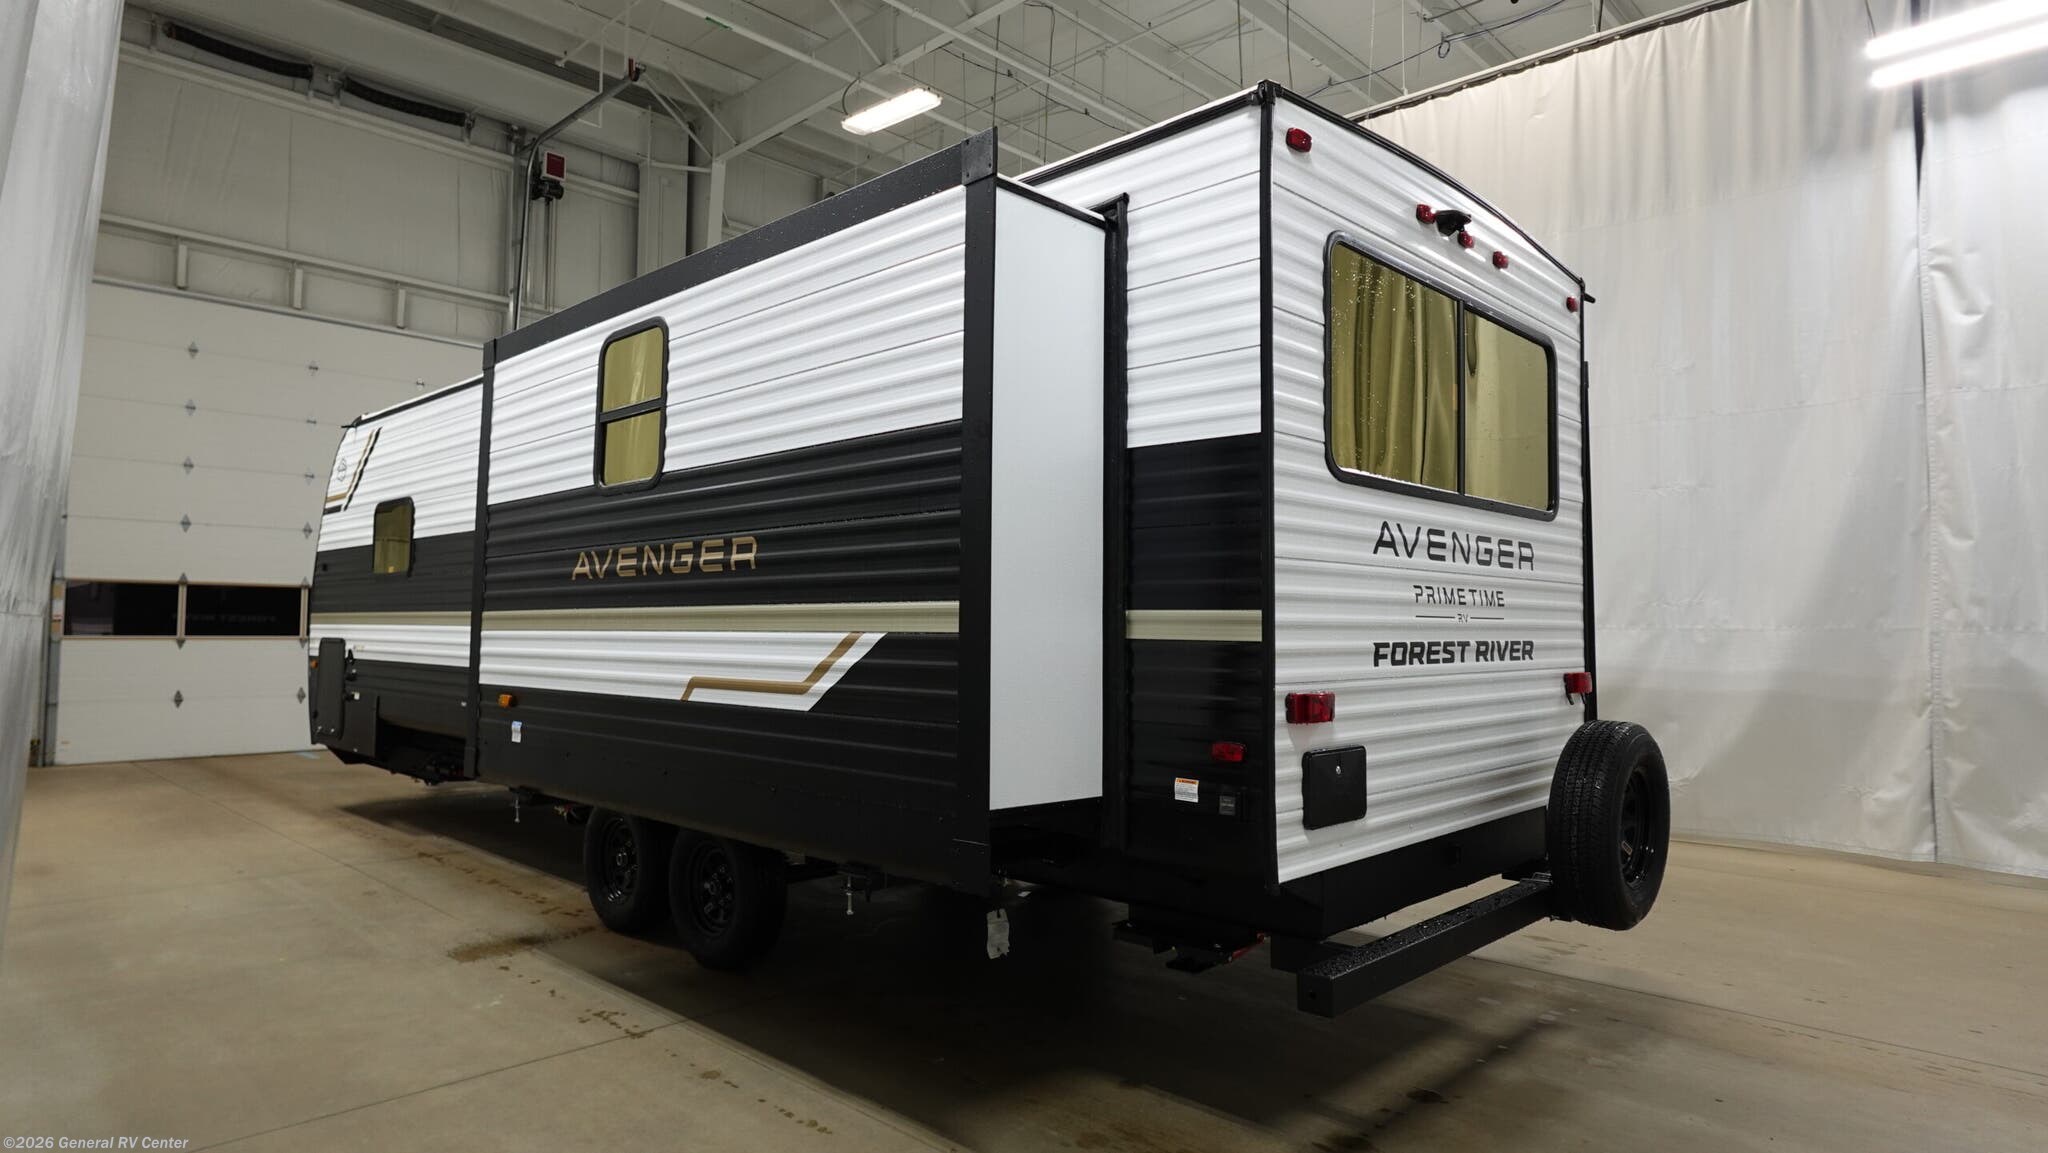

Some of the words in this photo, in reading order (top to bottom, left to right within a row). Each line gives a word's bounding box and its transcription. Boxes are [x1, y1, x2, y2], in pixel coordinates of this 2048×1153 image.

[571, 536, 758, 580] AVENGER
[1373, 521, 1535, 571] AVENGER
[1457, 613, 1469, 623] RV
[1373, 640, 1471, 667] FOREST
[1475, 640, 1534, 662] RIVER
